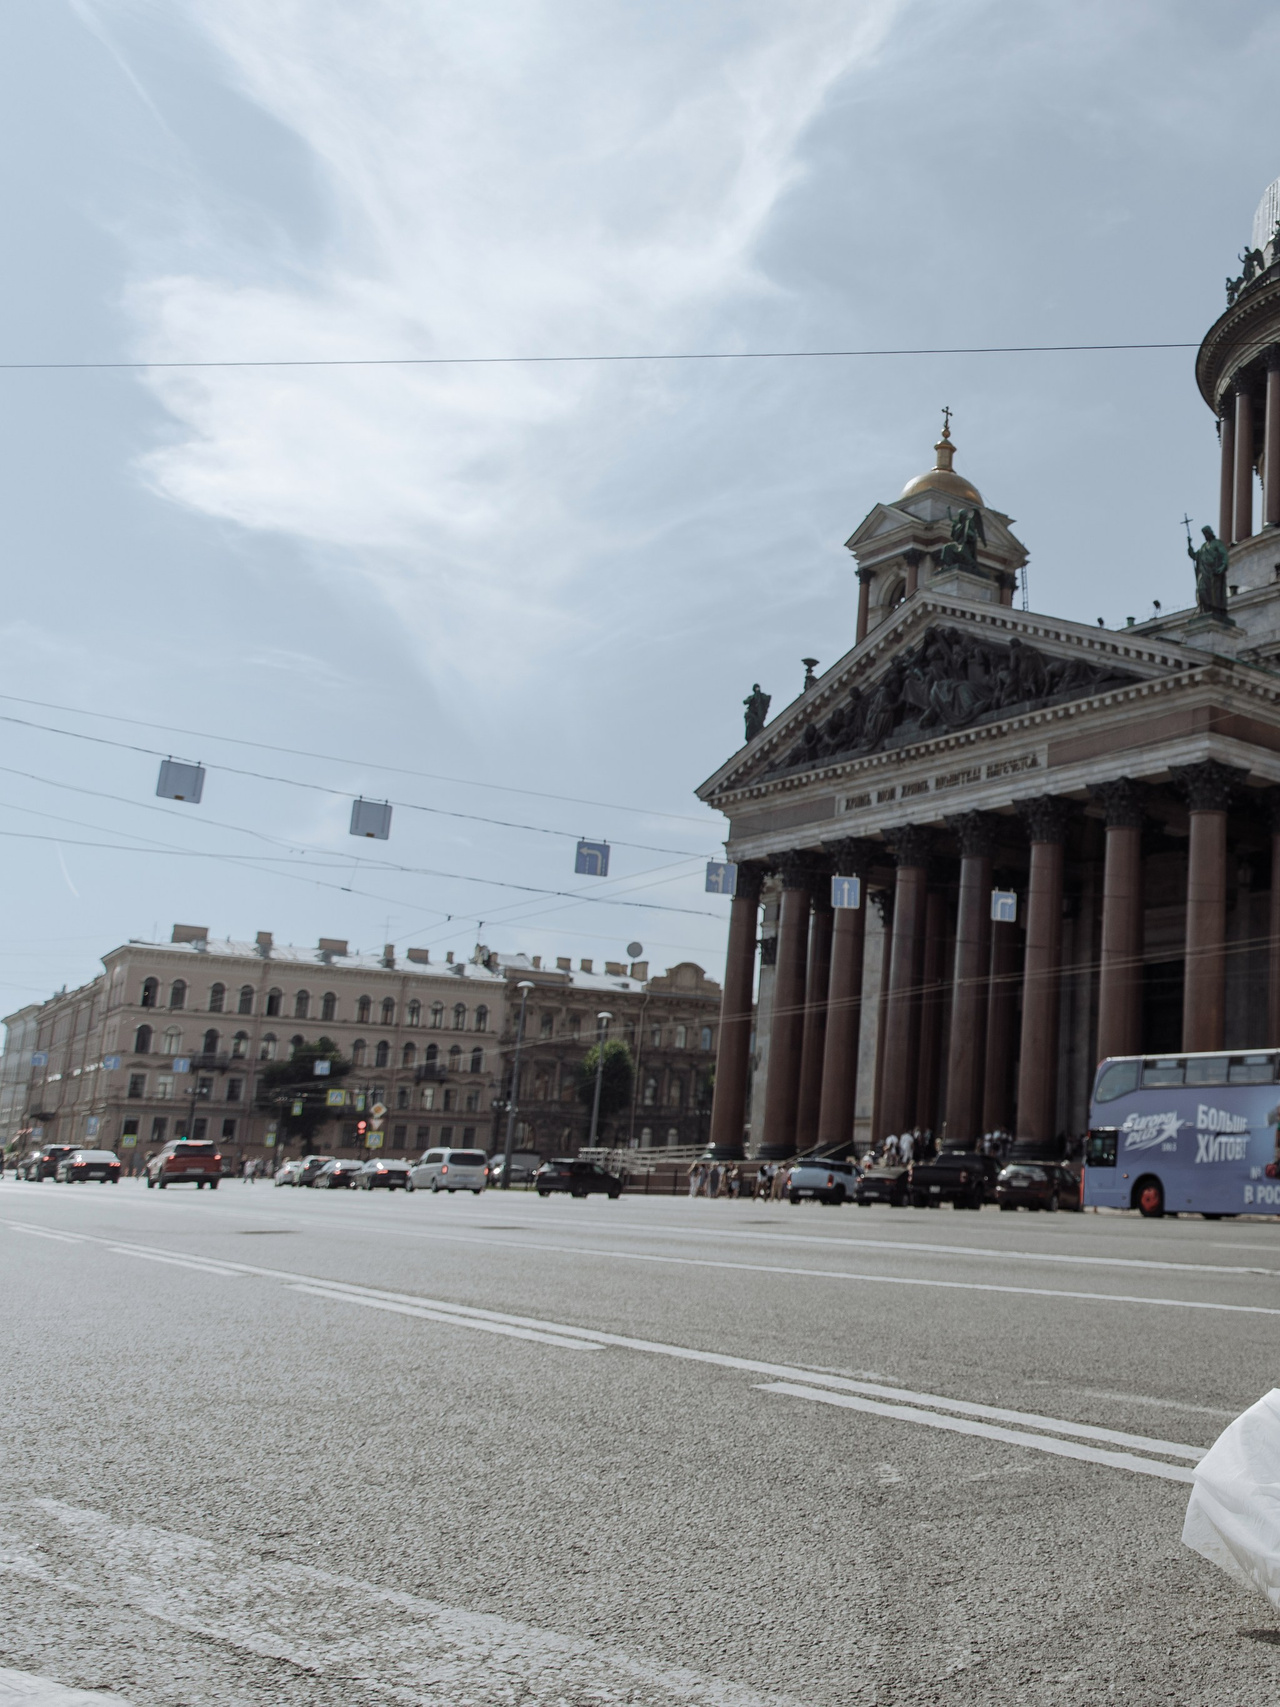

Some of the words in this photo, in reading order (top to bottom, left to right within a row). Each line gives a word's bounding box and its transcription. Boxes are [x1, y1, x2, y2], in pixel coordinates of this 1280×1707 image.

[1197, 1103, 1247, 1131] БОЛЬШЕ
[1195, 1133, 1247, 1163] ХИТОВ!
[1244, 1184, 1254, 1204] В
